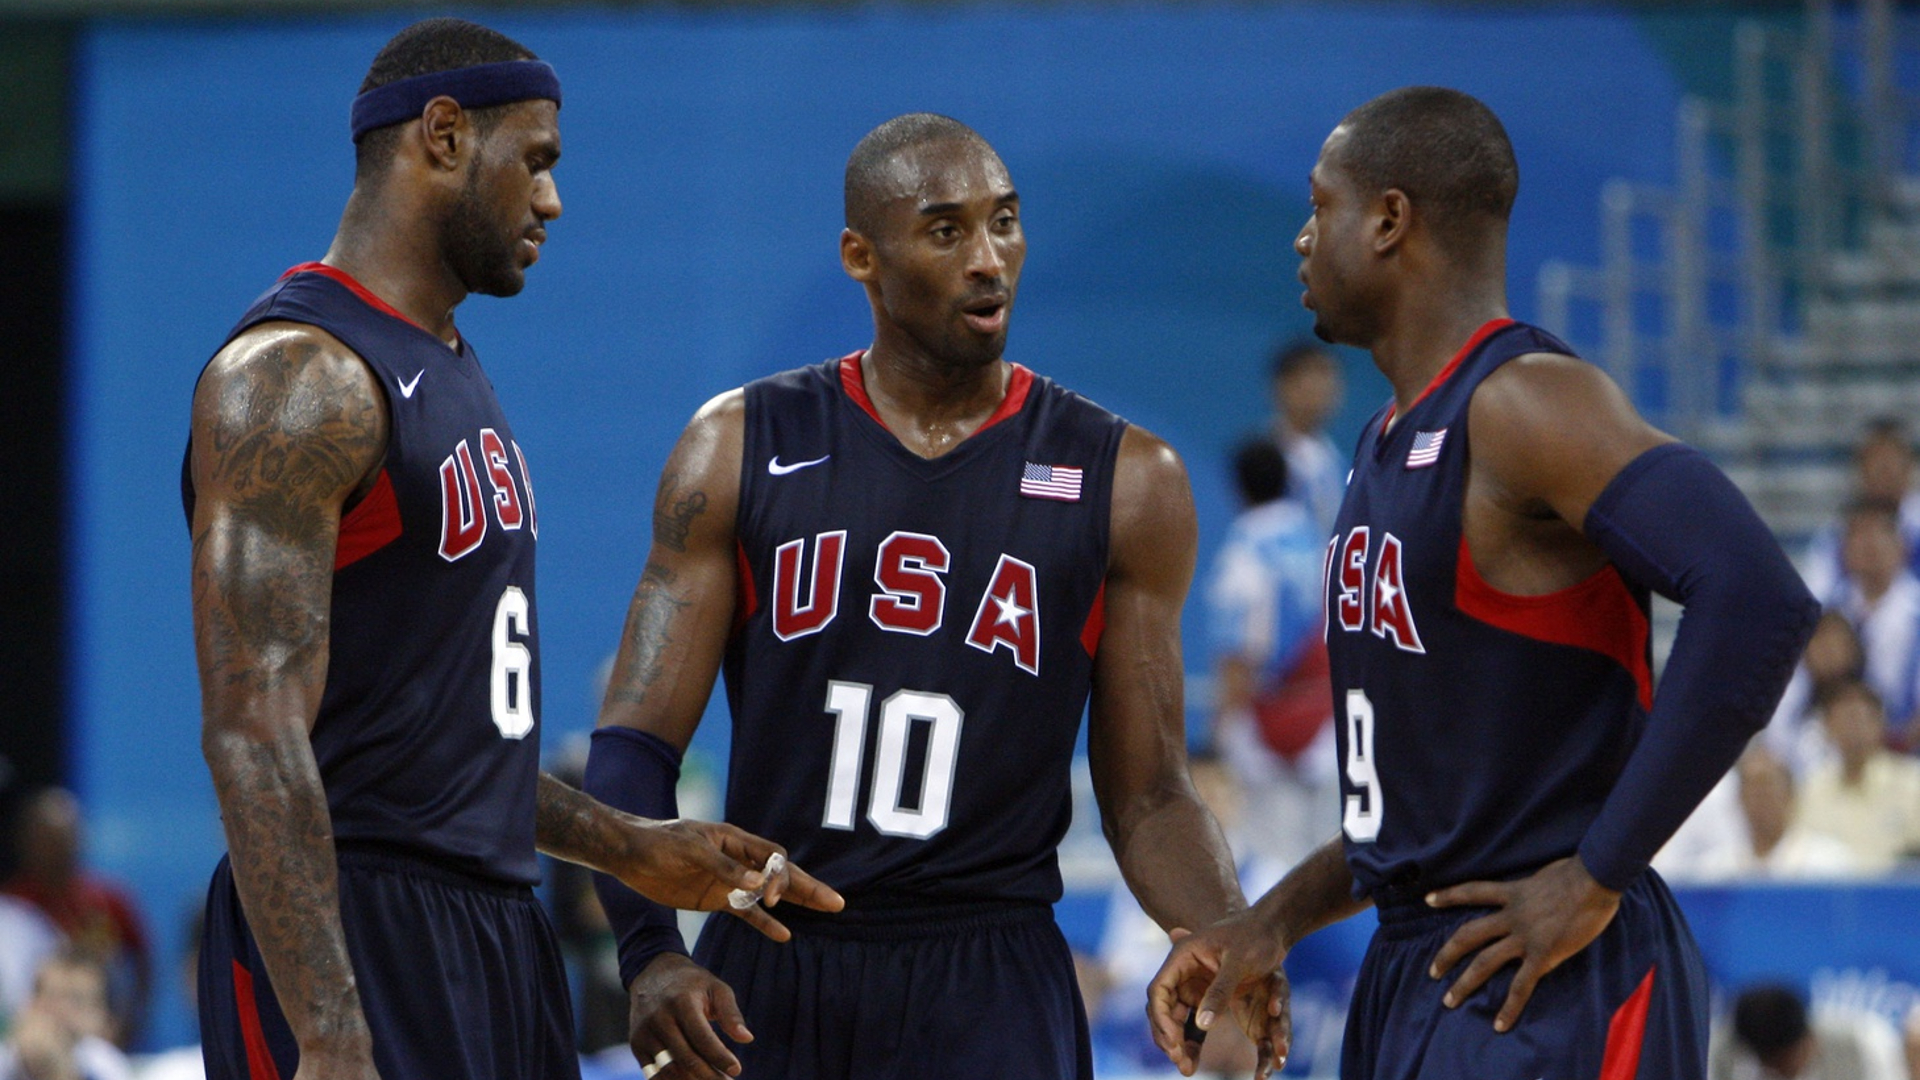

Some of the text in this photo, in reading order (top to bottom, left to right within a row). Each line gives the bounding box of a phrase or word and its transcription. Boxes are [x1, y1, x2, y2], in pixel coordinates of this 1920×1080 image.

[490, 585, 535, 740] 6
[773, 530, 1039, 677] USA
[821, 679, 965, 840] 10
[1343, 688, 1383, 843] 9
